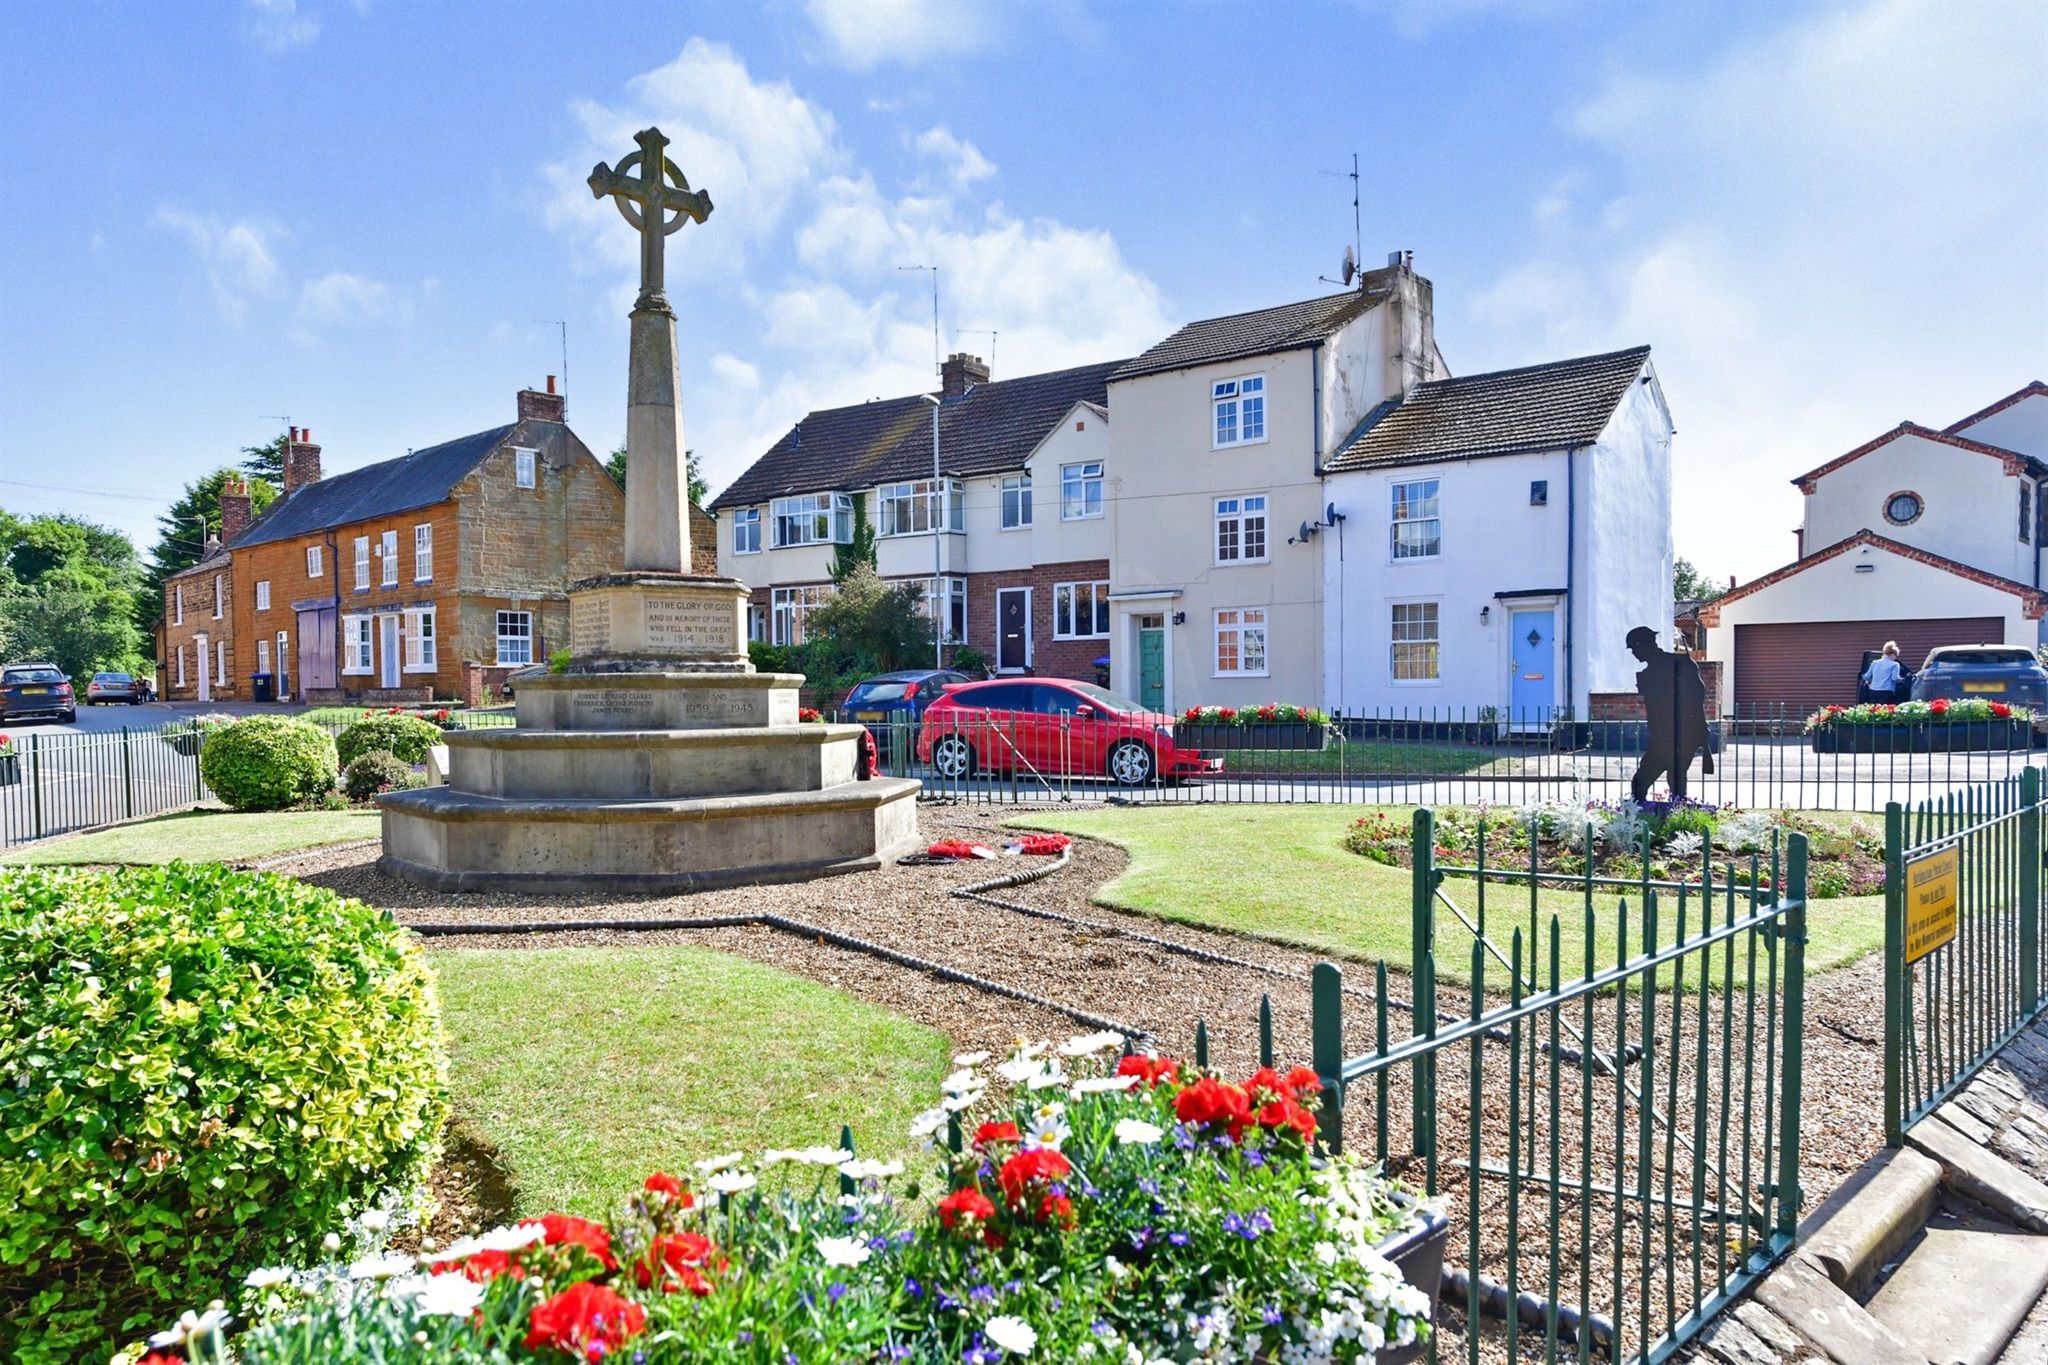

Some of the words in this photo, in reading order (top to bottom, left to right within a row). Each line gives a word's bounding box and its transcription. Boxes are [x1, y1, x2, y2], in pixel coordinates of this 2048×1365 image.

[648, 601, 658, 609] TO
[660, 601, 675, 609] THE
[676, 601, 701, 610] GLORY
[703, 602, 713, 611] OF
[649, 614, 664, 622] AND
[666, 625, 682, 633] FELL
[674, 634, 694, 643] 1914
[705, 634, 725, 644] 1918
[711, 693, 728, 701] AND
[685, 703, 709, 713] 1939
[731, 703, 753, 713] 1945
